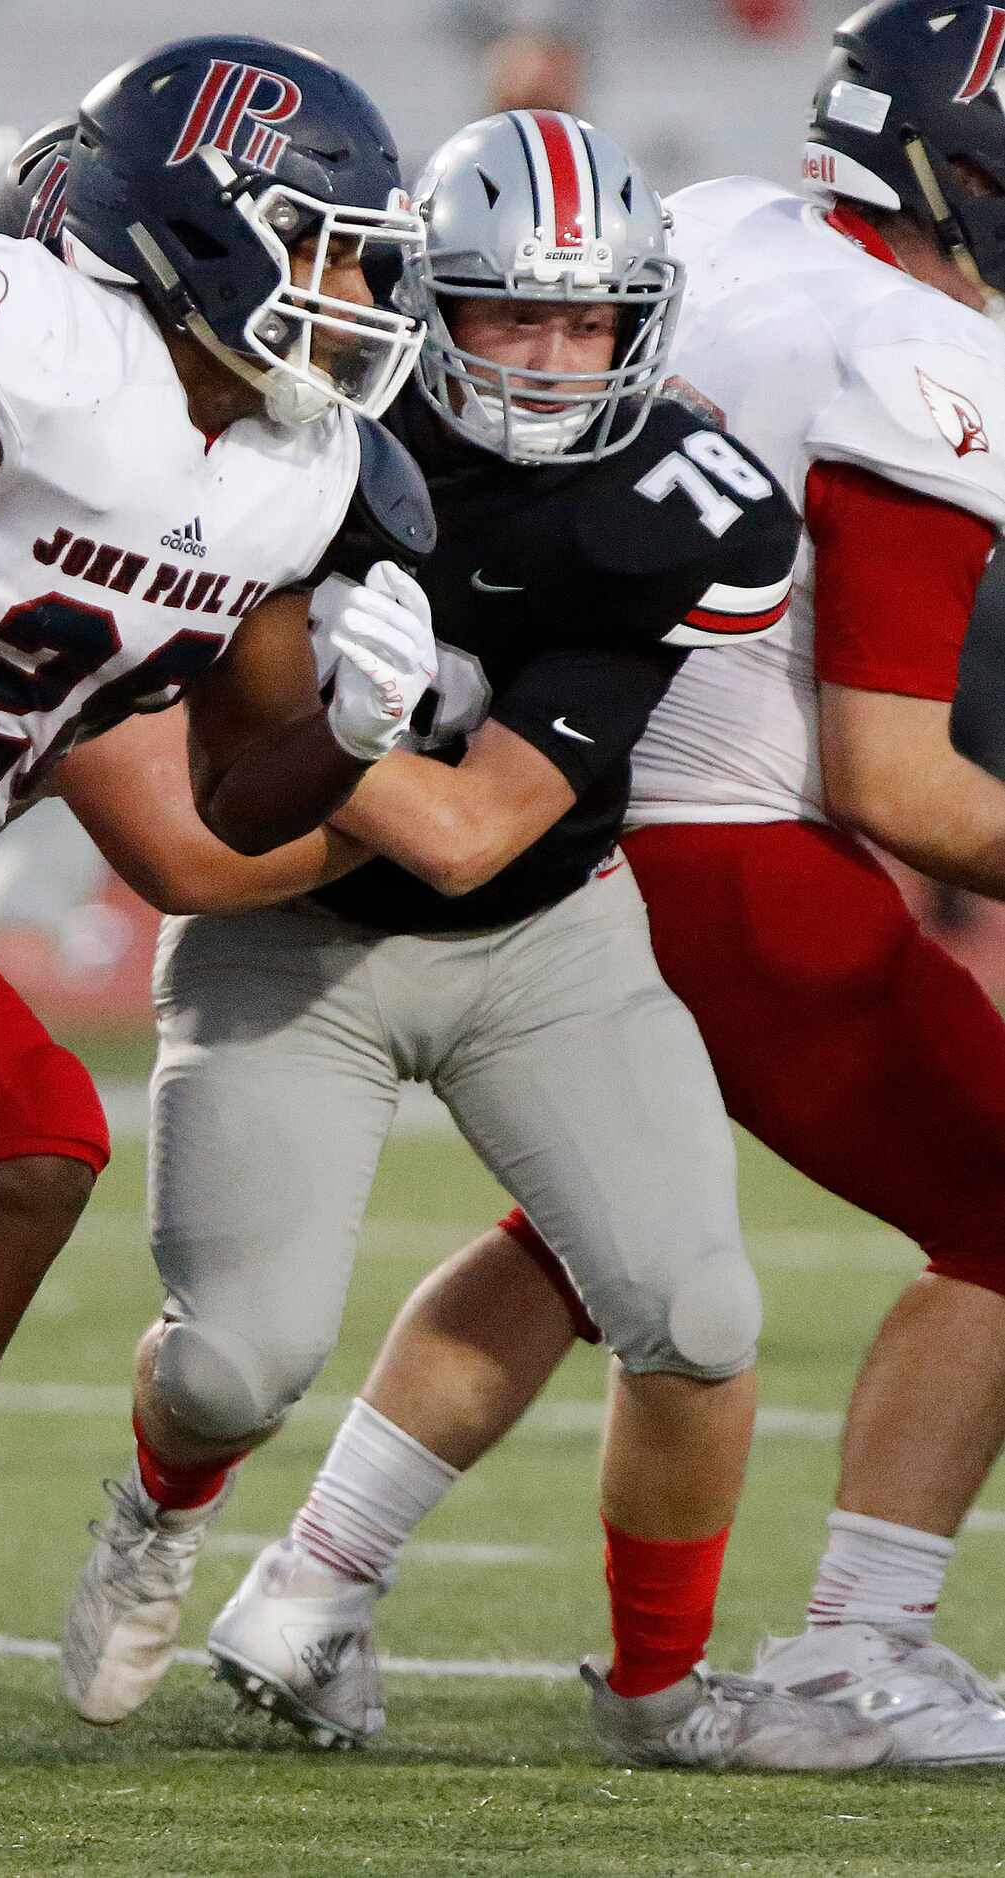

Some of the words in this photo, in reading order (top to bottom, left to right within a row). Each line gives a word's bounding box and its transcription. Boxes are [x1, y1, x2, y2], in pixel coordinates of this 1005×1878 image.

[633, 428, 774, 539] 78
[32, 525, 150, 595] JOHN
[142, 561, 232, 615] PAUL
[160, 534, 208, 559] adidas
